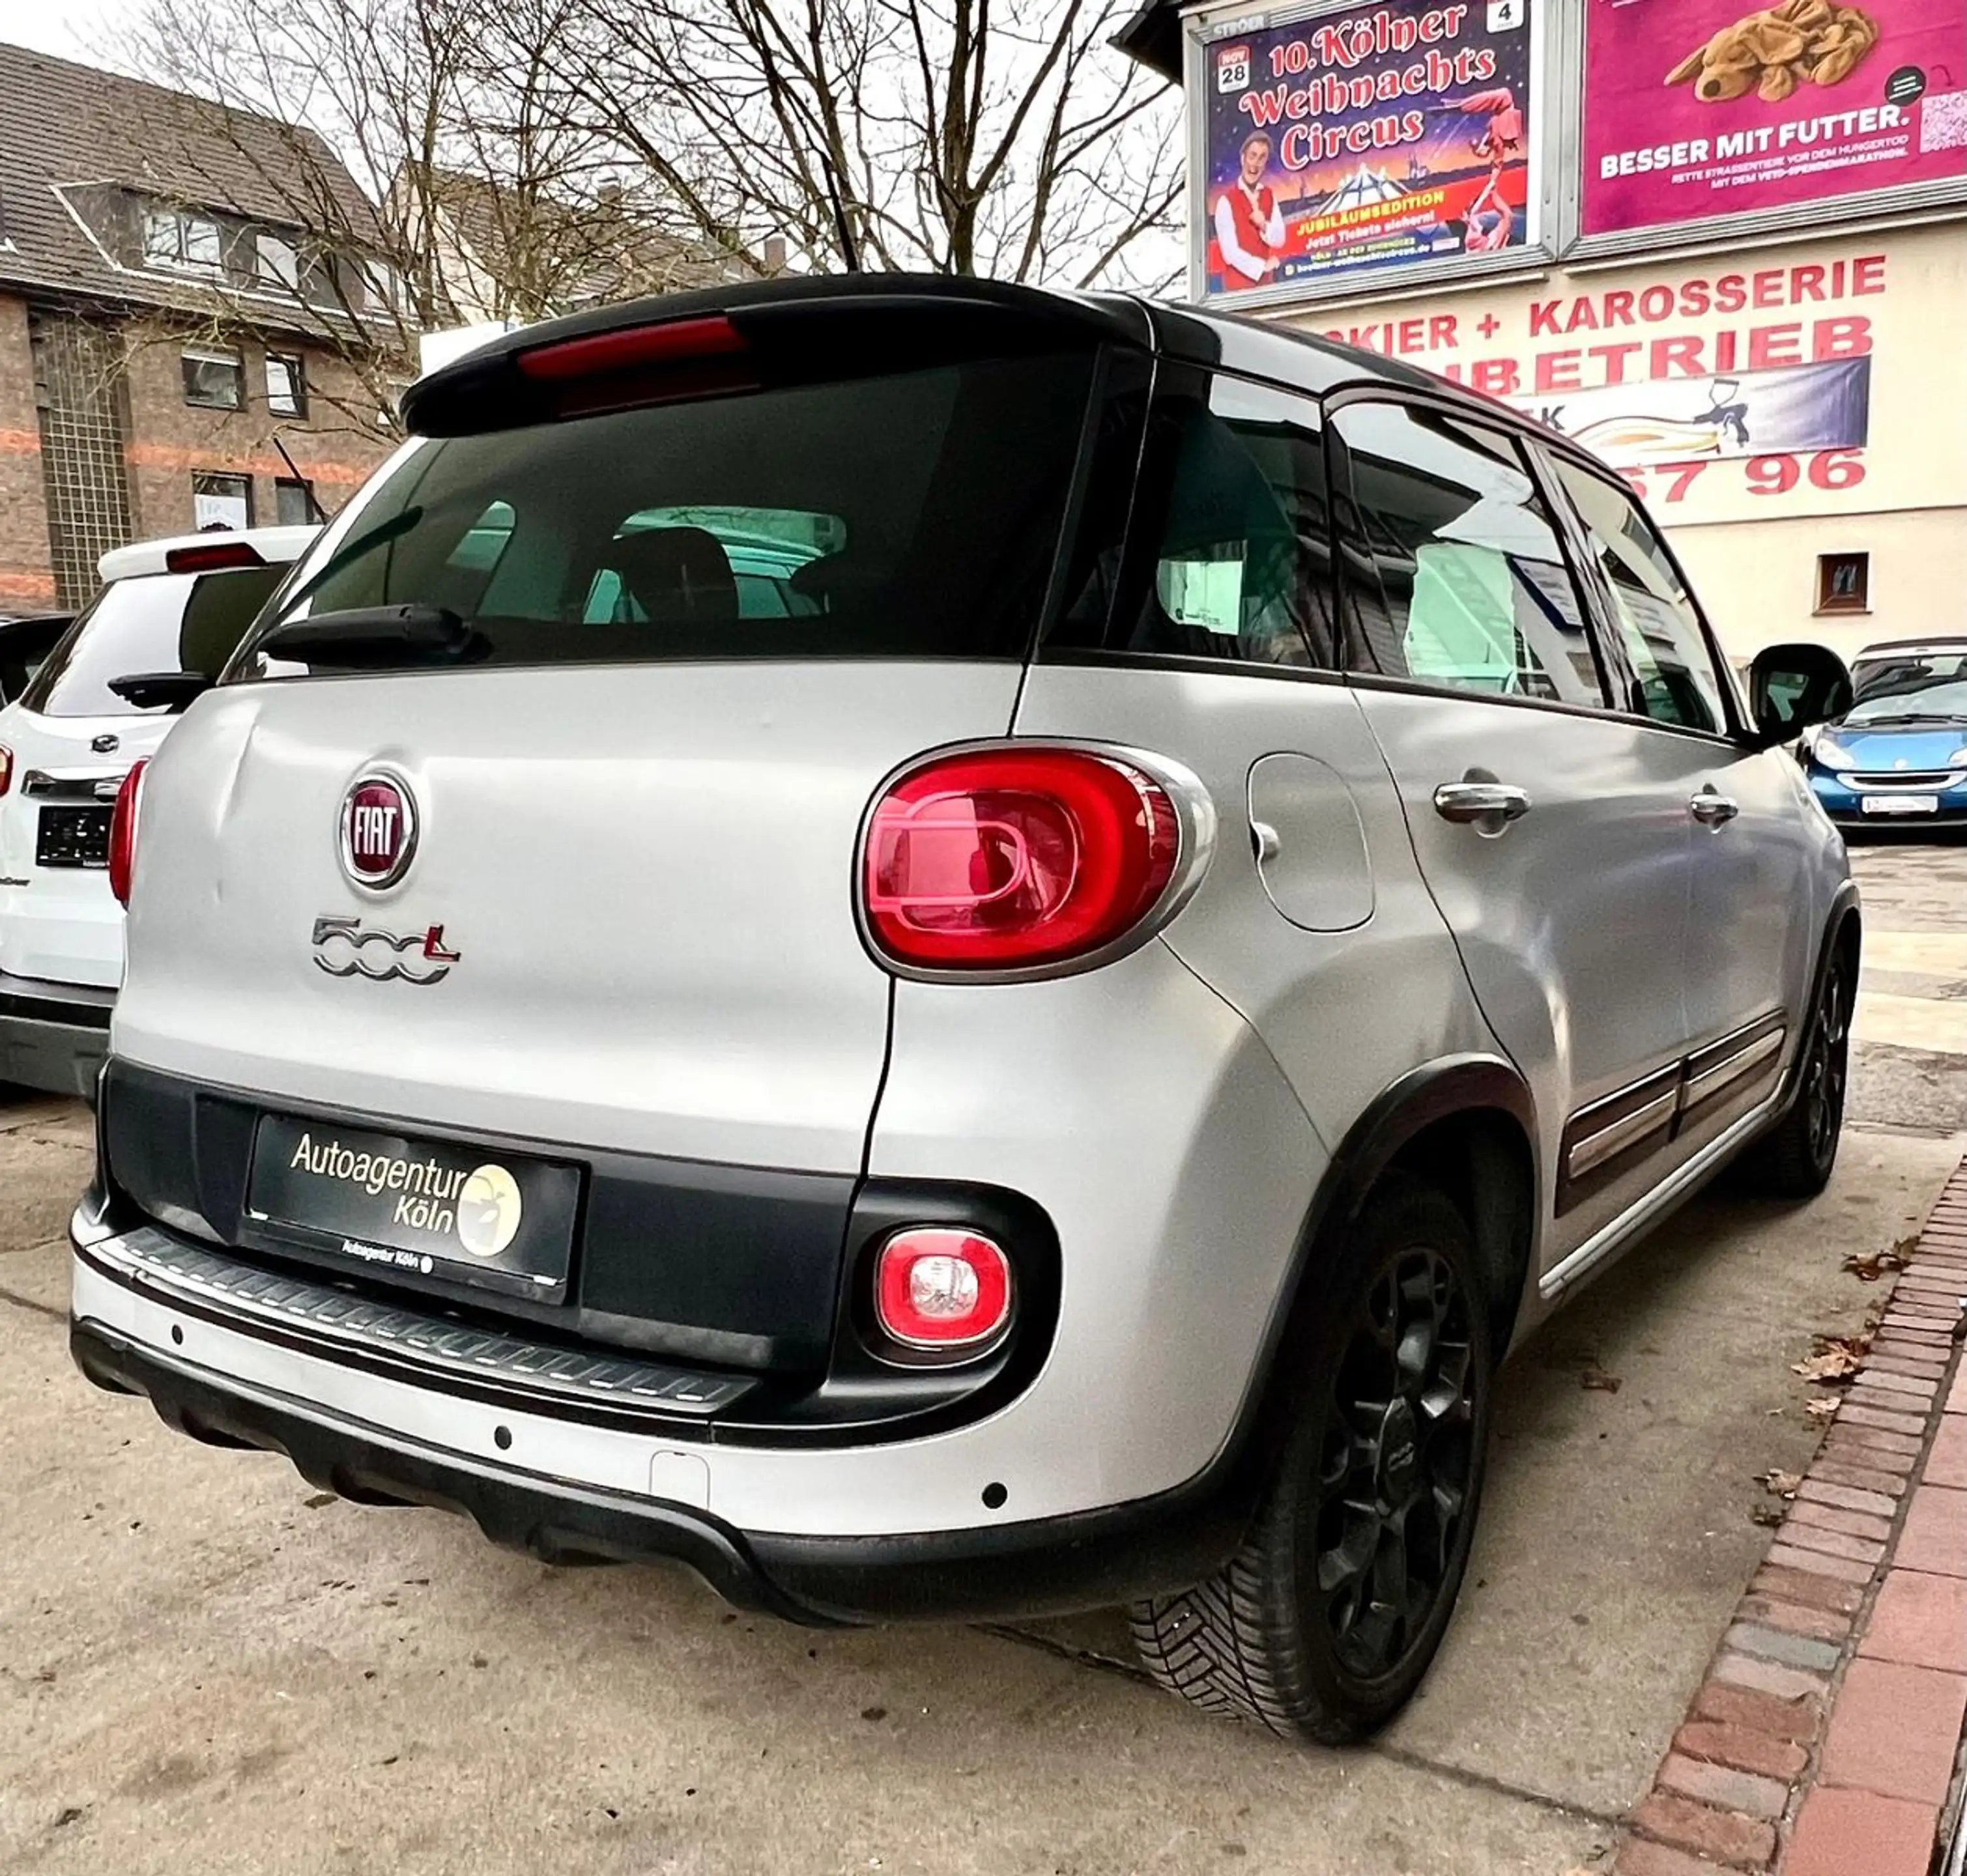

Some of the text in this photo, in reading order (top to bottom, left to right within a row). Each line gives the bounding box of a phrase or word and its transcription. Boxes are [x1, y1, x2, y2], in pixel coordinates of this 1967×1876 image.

[1498, 3, 1512, 20] 4
[1222, 50, 1246, 65] NOV
[1269, 5, 1468, 77] 10. Kölner
[1222, 65, 1246, 84] 28
[1239, 47, 1497, 127] Weihnachts
[1281, 109, 1424, 170] Circus
[1600, 104, 1911, 179] BESSER MIT FUTTER.
[1671, 169, 1704, 184] RETTE
[1787, 151, 1811, 164] VOR
[1811, 147, 1837, 161] DEM
[1838, 134, 1910, 156] HUNGERTOD
[1710, 177, 1730, 190] MIT
[1731, 172, 1757, 186] DEM
[1297, 191, 1445, 236] JUBILÄUMSEDITION
[1306, 210, 1435, 250] Jetzt Tickets sichern!
[1530, 255, 1887, 338] KAROSSERIE
[1444, 315, 1874, 397] BETRIEB
[1745, 449, 1867, 495] 96
[354, 806, 397, 855] FIAT
[312, 915, 461, 986] 500L
[290, 1133, 469, 1201] Autoagentur
[394, 1194, 455, 1234] Köln
[342, 1239, 419, 1268] Autoagentur Köln
